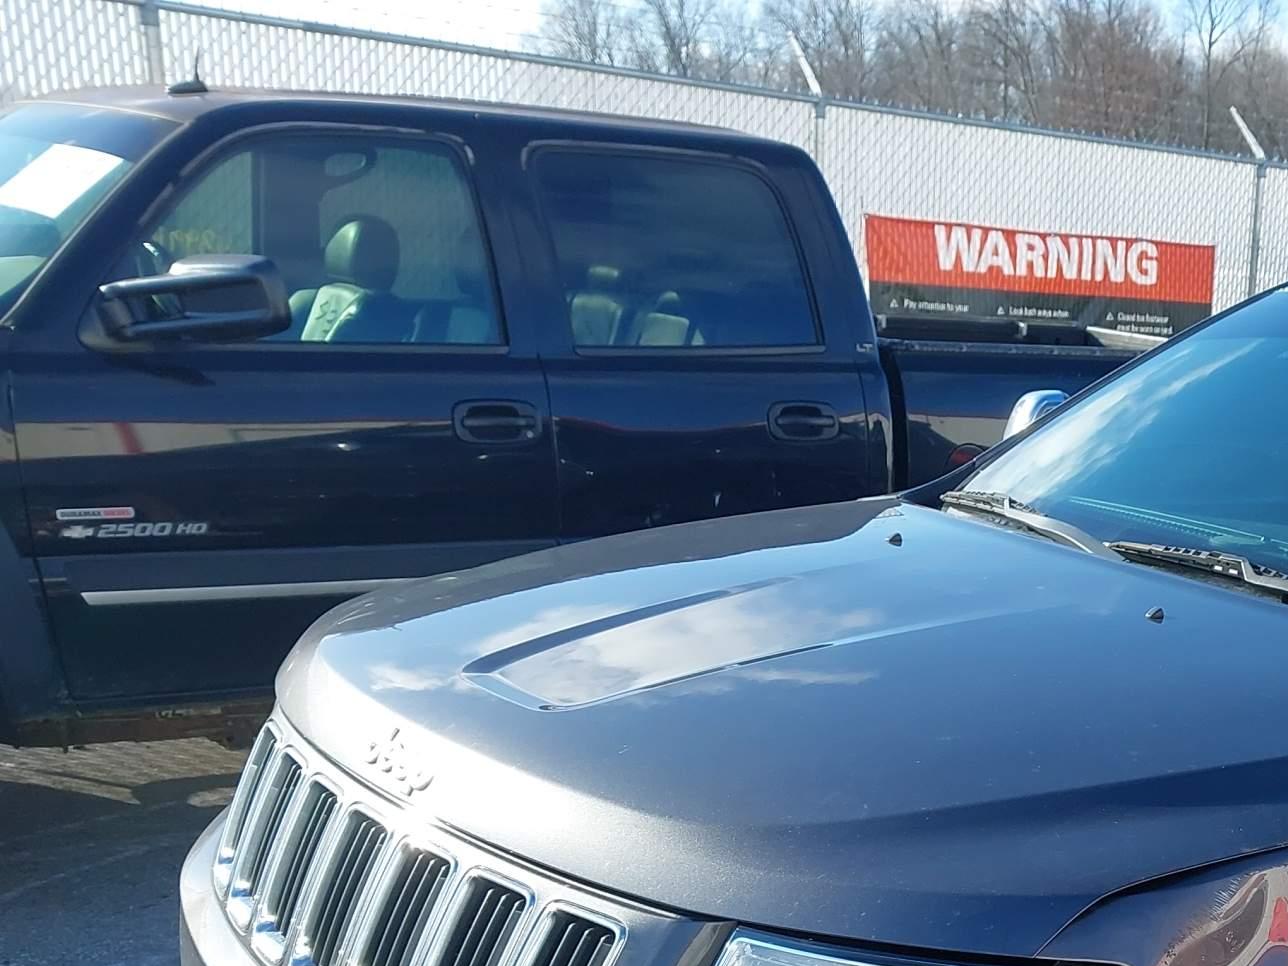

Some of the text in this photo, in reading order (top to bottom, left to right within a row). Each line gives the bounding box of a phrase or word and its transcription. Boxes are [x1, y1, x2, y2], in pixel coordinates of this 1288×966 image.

[934, 224, 1159, 286] WARNING
[97, 522, 208, 538] 2500 HD
[366, 727, 434, 797] Jeep
